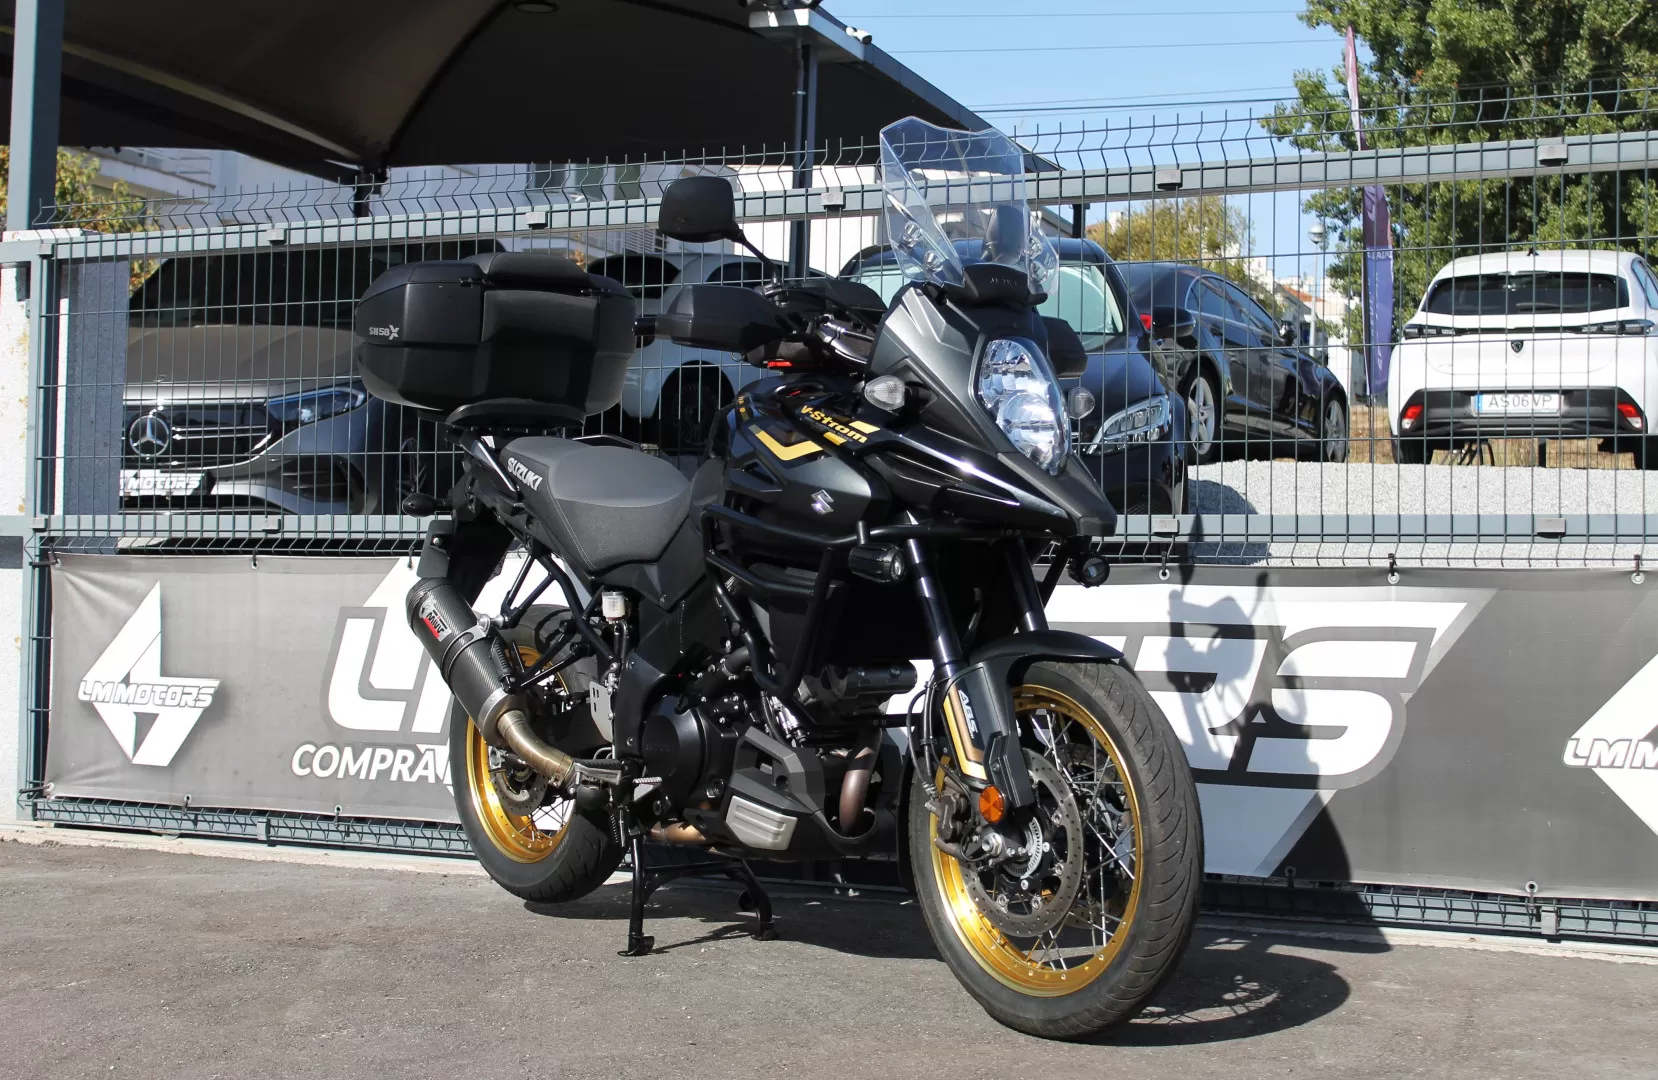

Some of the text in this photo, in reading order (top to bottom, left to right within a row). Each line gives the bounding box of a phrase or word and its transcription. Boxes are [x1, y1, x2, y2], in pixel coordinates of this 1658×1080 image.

[507, 456, 543, 491] SUZUKI
[77, 680, 215, 708] LM MOTORS
[957, 689, 979, 739] ABS
[1562, 738, 1633, 768] LM
